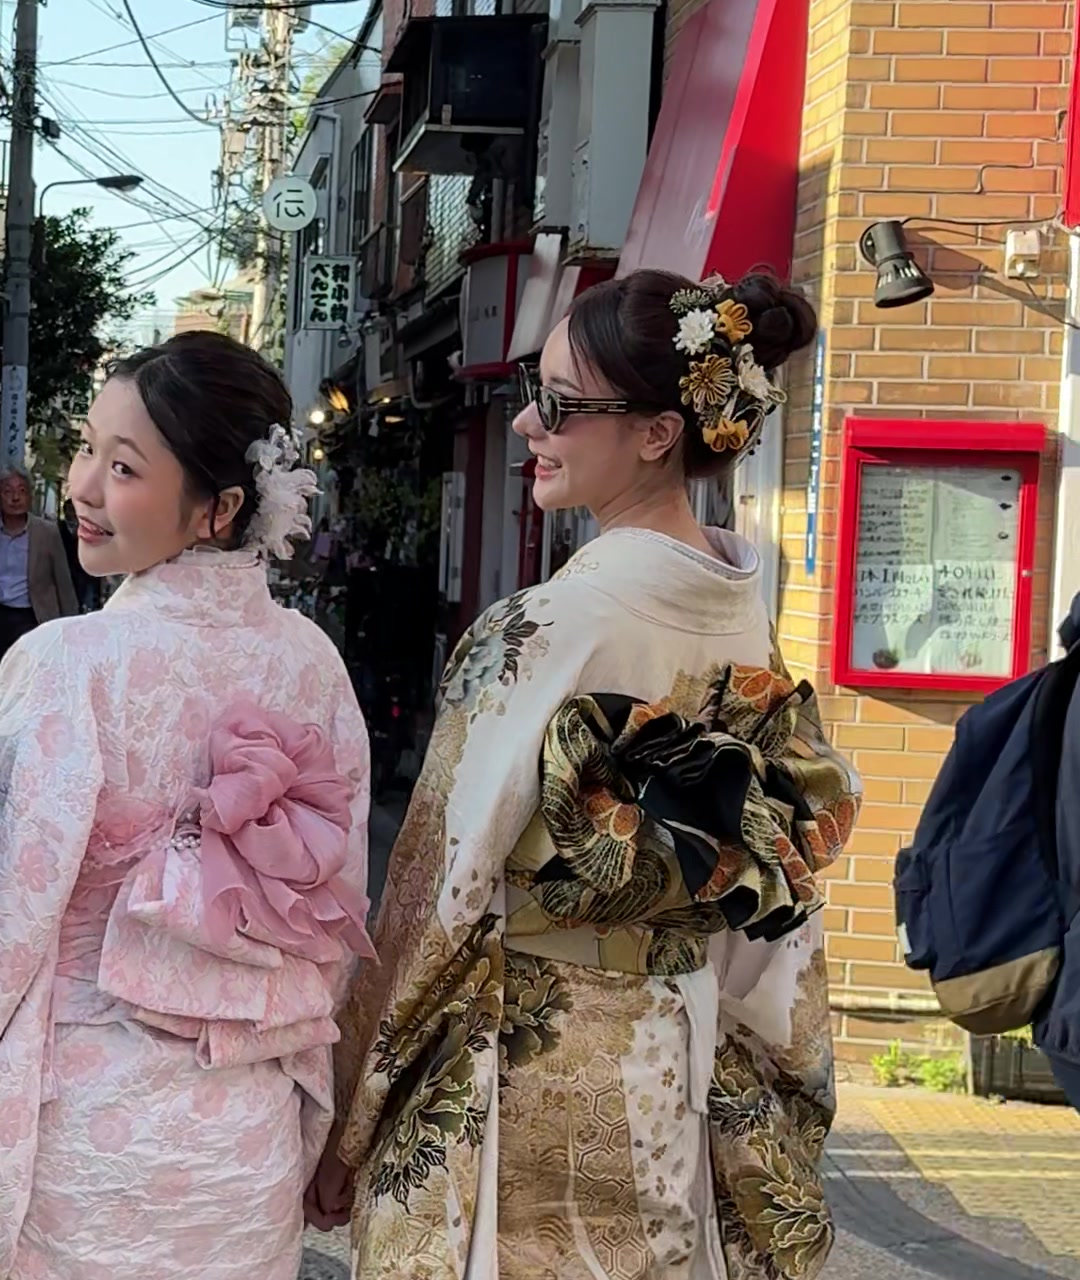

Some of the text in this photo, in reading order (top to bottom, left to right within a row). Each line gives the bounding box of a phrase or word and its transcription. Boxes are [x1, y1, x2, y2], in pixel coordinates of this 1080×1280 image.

[272, 188, 306, 218] 伝
[309, 263, 331, 323] べんてん
